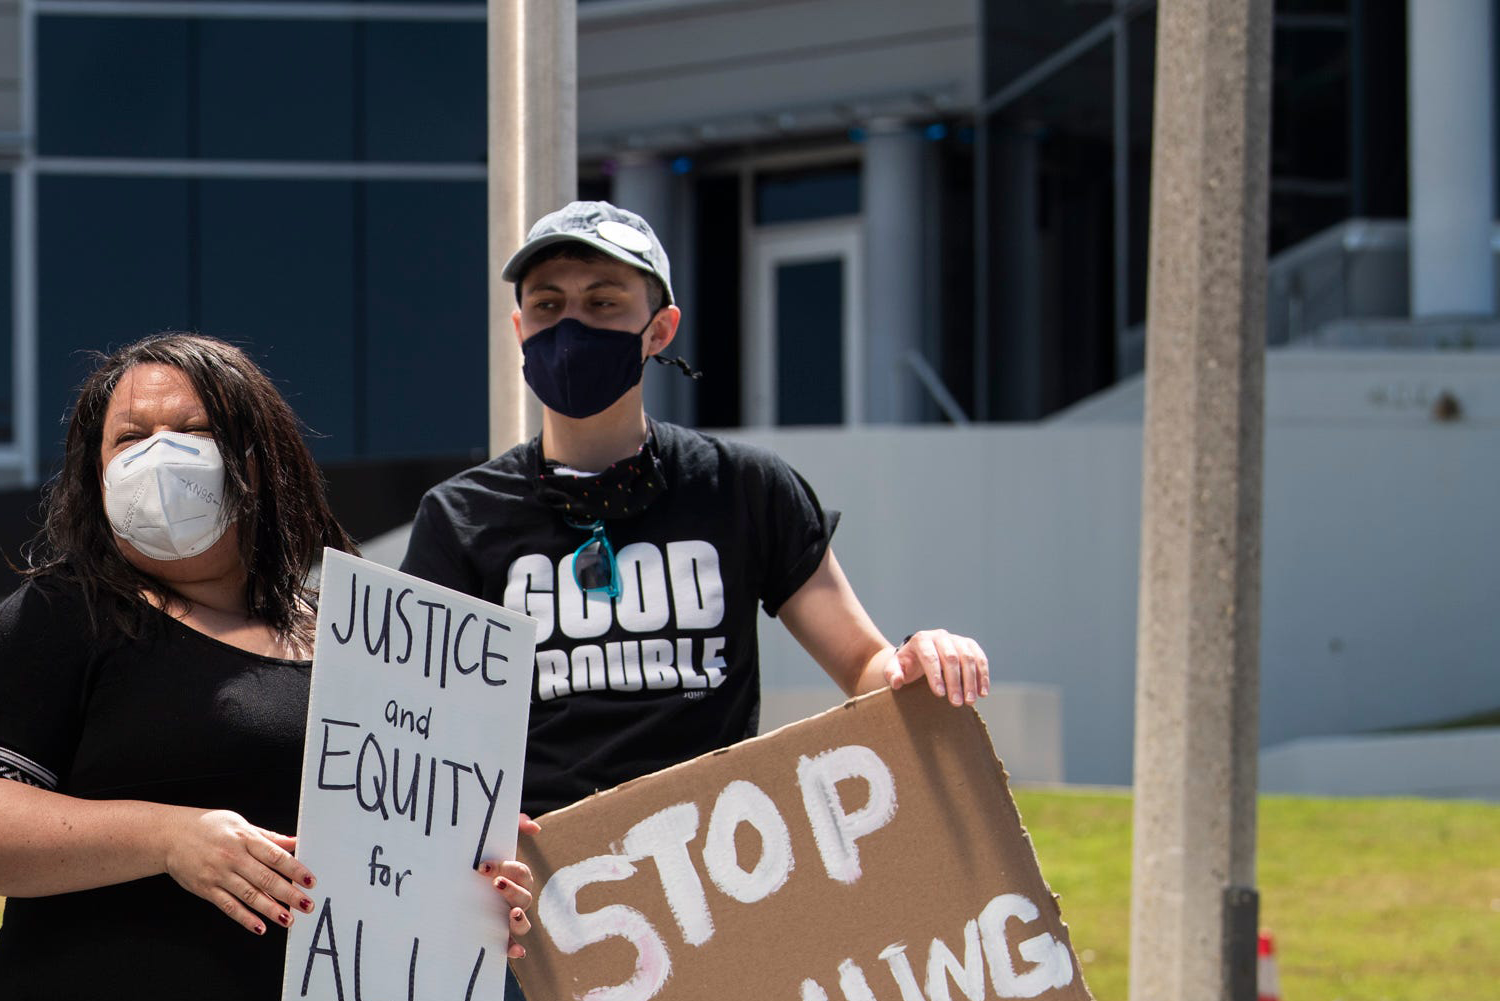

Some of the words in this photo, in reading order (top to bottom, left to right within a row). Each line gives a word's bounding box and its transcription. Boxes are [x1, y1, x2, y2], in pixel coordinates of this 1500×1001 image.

[332, 573, 512, 688] JUSTICE
[504, 540, 725, 644] GOOD
[536, 637, 727, 701] ROUBLE
[385, 699, 431, 738] and
[318, 718, 504, 870] EQUITY
[369, 845, 412, 897] for
